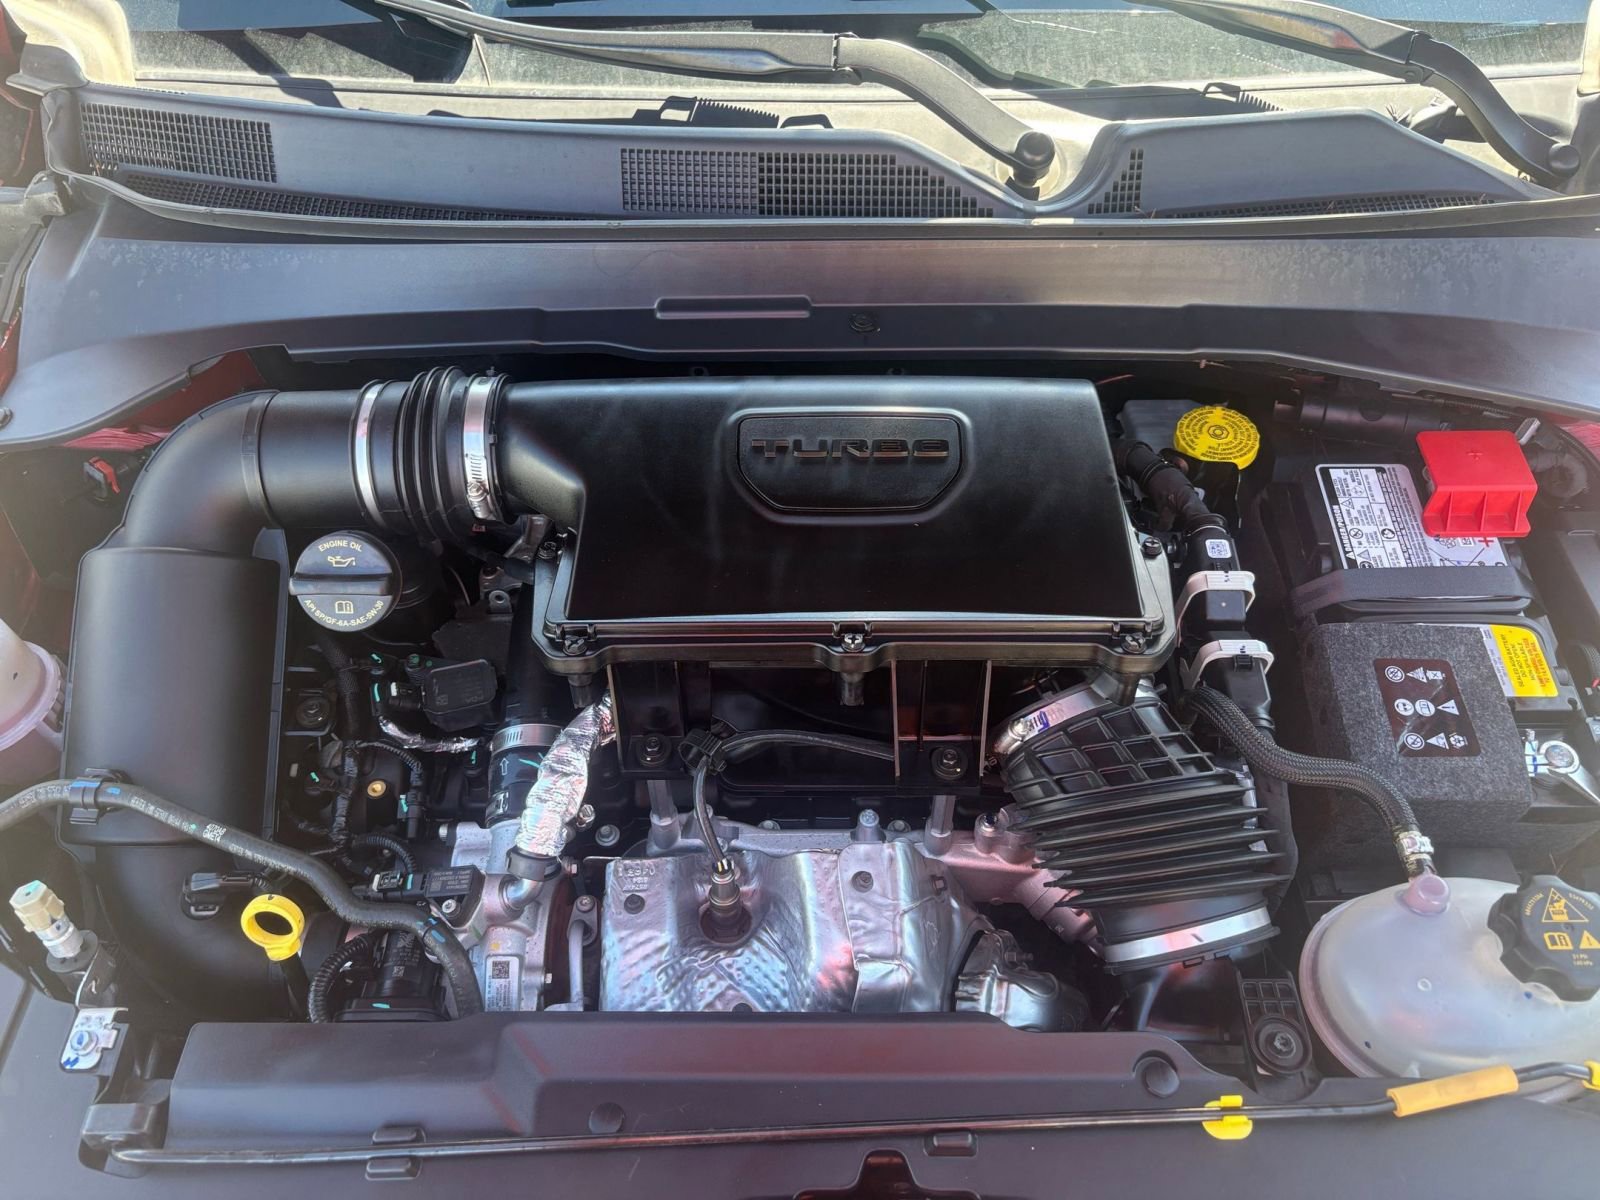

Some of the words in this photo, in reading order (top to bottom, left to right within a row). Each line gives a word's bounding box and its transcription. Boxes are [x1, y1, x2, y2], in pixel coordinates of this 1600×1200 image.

[751, 438, 950, 459] TURBO
[318, 540, 348, 552] ENGINE
[350, 540, 362, 552] OIL
[304, 600, 316, 612] API
